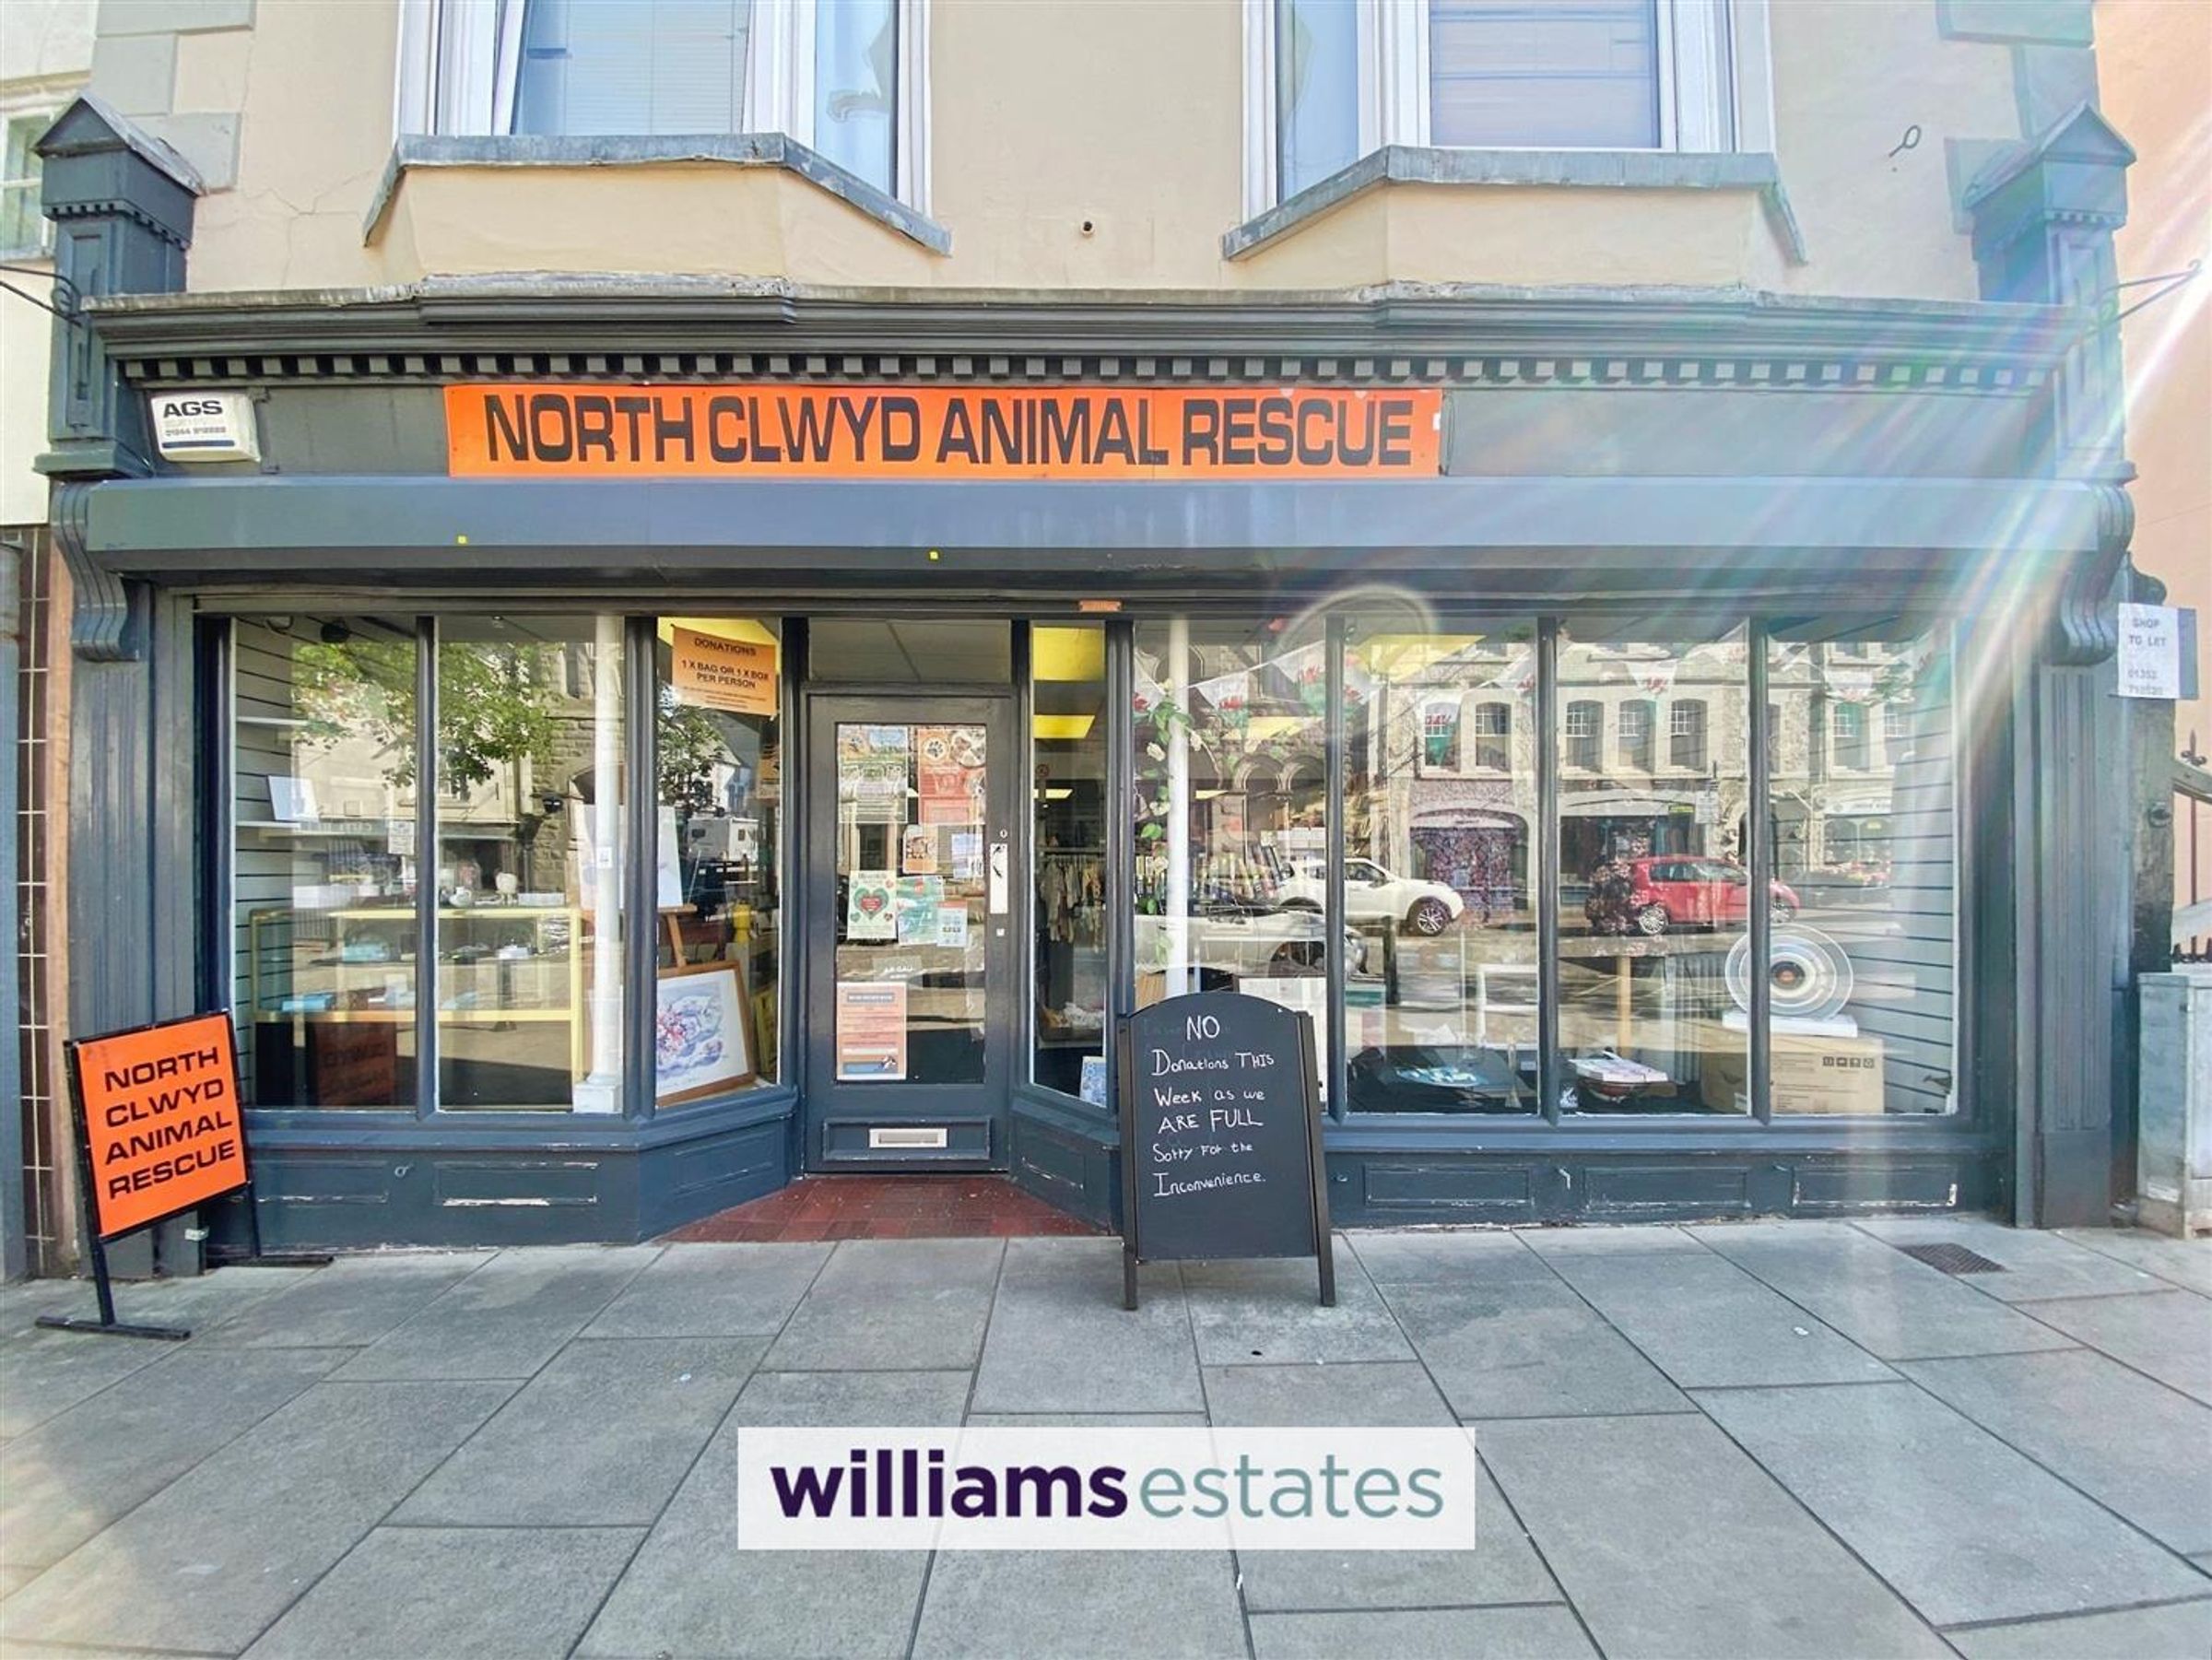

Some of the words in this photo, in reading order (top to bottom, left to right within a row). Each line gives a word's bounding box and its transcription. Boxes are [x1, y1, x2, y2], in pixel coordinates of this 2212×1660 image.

[163, 400, 223, 418] AGS
[484, 394, 695, 464] NORTH
[708, 395, 920, 464] CLWYD
[935, 397, 1169, 465] ANIMAL
[1182, 398, 1414, 466] RESCUE
[2132, 618, 2160, 629] SHOP
[694, 637, 757, 656] DONATIONS
[2128, 635, 2143, 646] TO
[2147, 636, 2168, 647] LET
[696, 672, 716, 683] PER
[718, 676, 757, 689] PERSON
[697, 662, 719, 673] BAG
[720, 665, 735, 676] OR
[750, 670, 770, 681] BOX
[1186, 1015, 1220, 1041] NO
[104, 1047, 219, 1092] NORTH
[1151, 1049, 1230, 1076] Donations
[1235, 1052, 1275, 1069] THIS
[105, 1078, 224, 1128] CLWYD
[1154, 1087, 1203, 1106] Week
[1214, 1089, 1235, 1101] as
[1243, 1090, 1266, 1101] we
[1158, 1114, 1200, 1135] ARE
[1209, 1109, 1264, 1132] FULL
[105, 1112, 232, 1165] ANIMAL
[1152, 1143, 1194, 1162] Sorry
[1230, 1142, 1254, 1154] the
[108, 1139, 236, 1199] RESCUE
